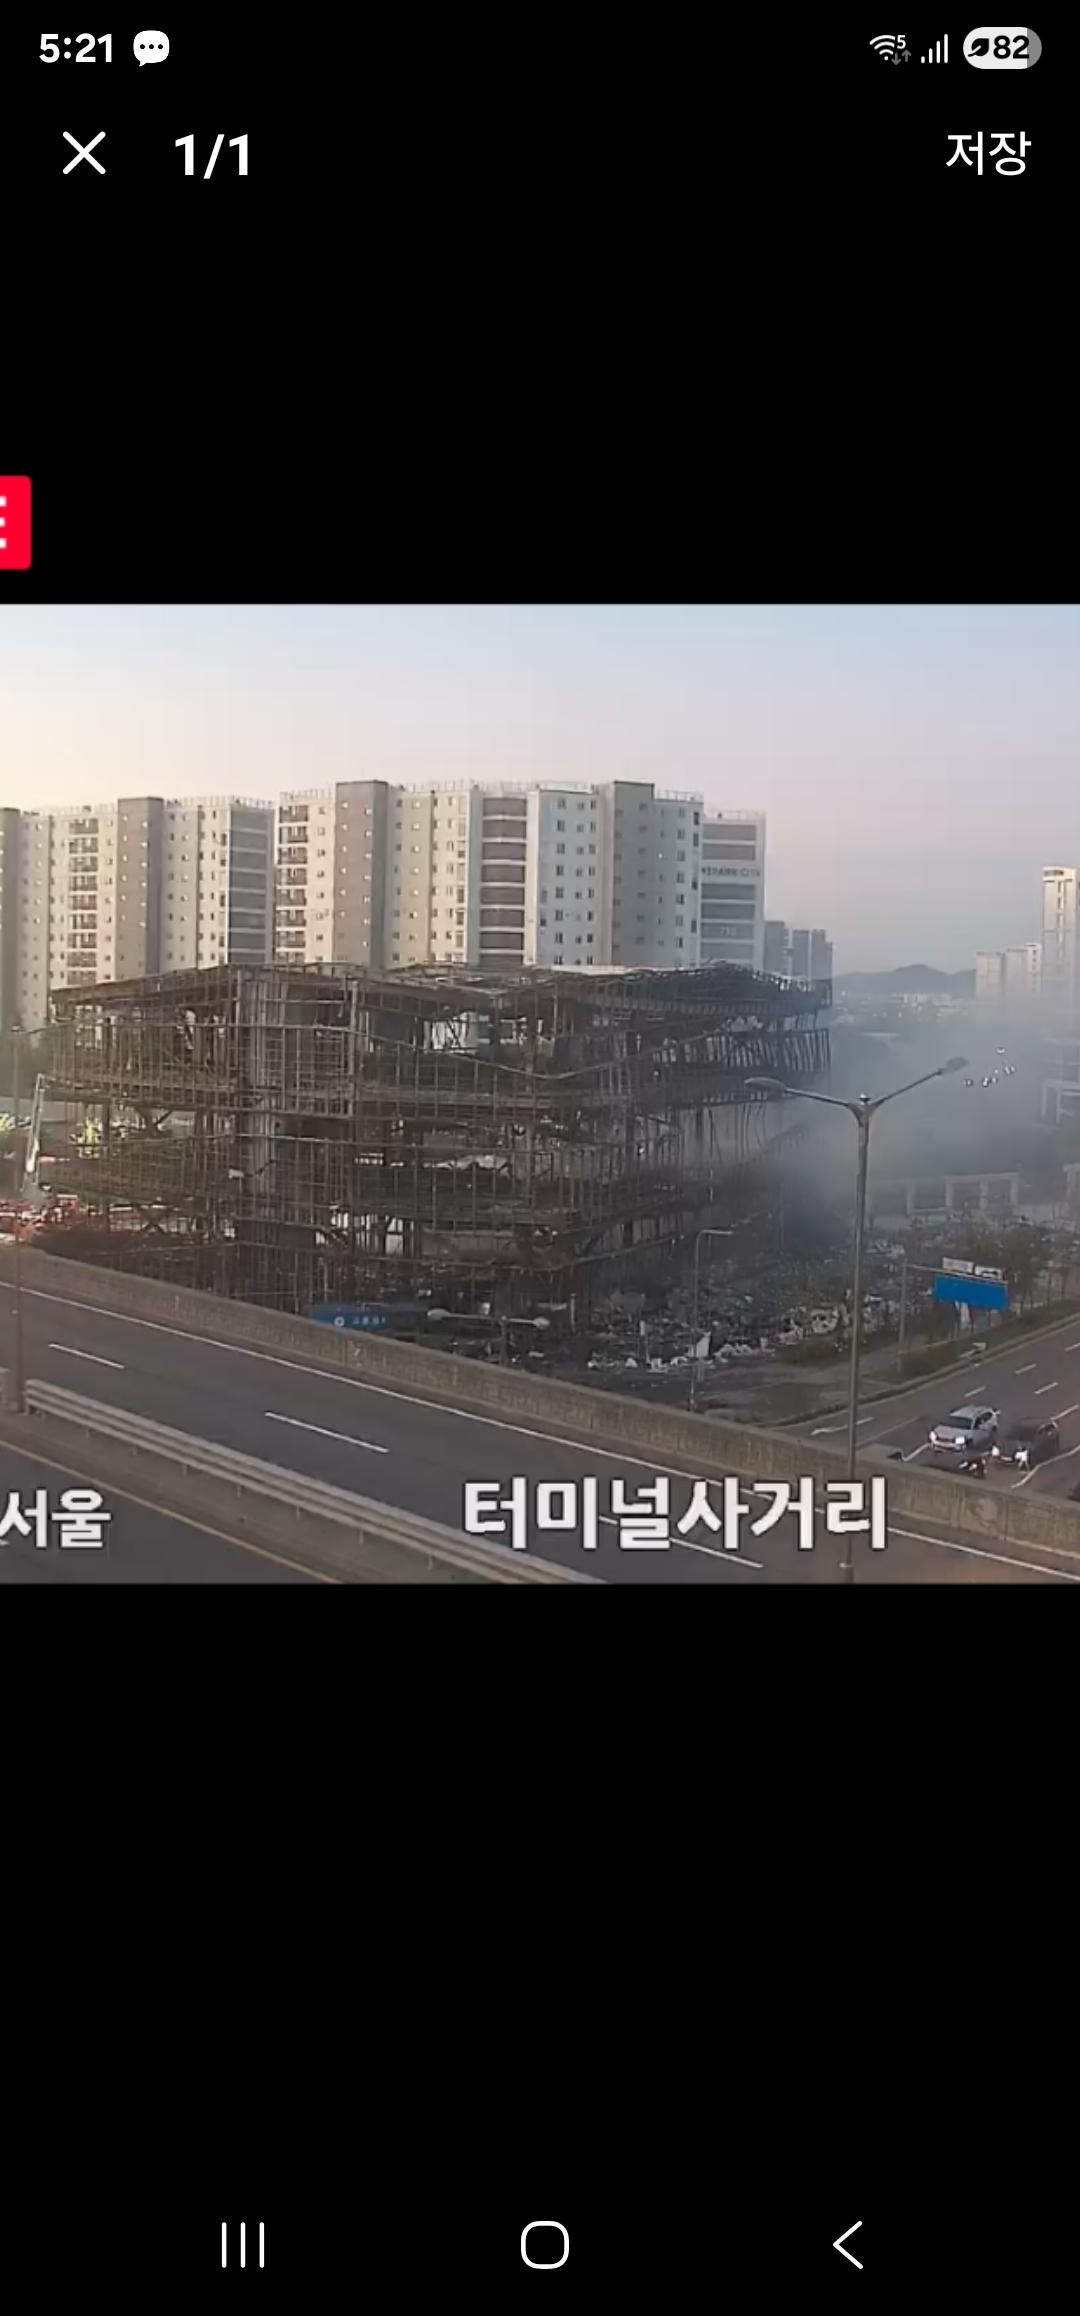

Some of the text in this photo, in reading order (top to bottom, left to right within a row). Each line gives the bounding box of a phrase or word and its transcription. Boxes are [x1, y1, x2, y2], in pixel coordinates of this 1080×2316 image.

[39, 33, 112, 64] 5:21
[993, 35, 1030, 60] 82
[175, 133, 249, 180] 1/1
[944, 131, 1032, 177] 저장
